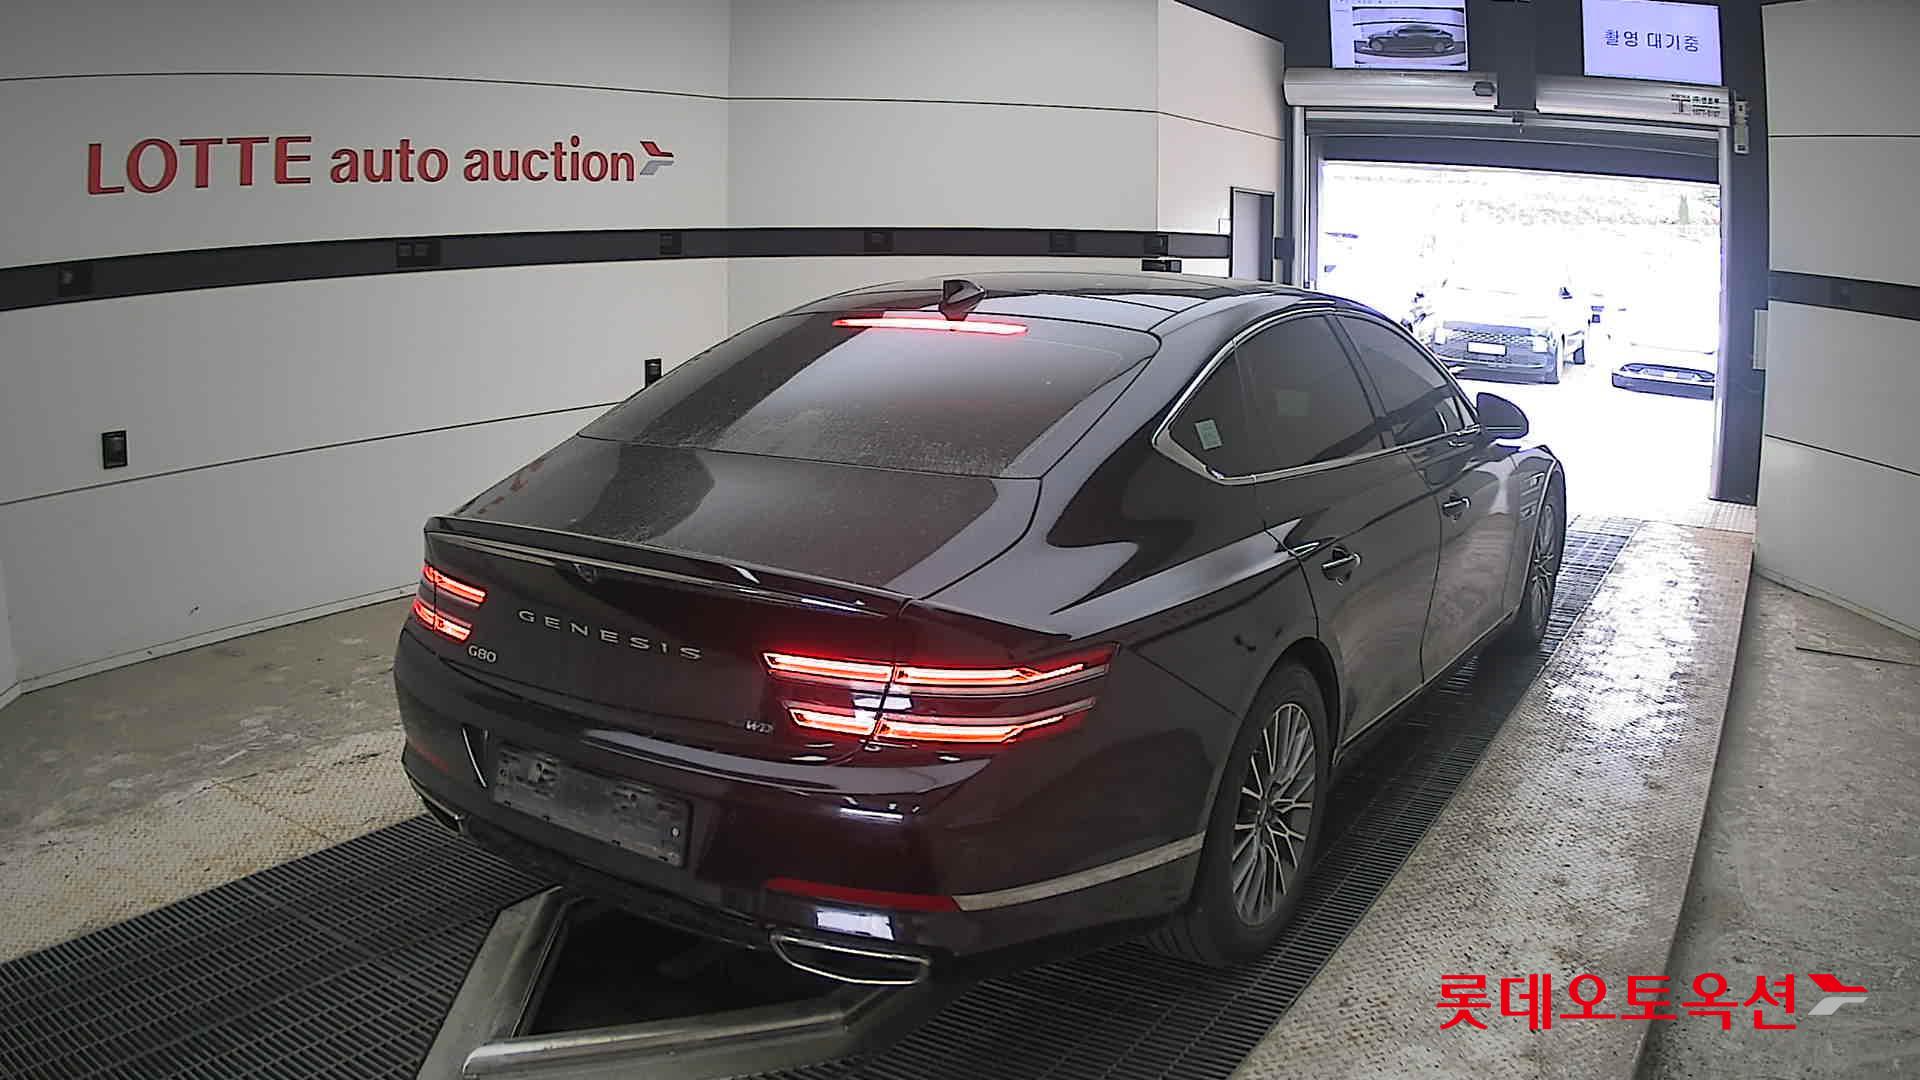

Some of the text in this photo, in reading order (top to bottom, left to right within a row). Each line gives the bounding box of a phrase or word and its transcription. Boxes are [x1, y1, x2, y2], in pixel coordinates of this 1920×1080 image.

[1647, 32, 1699, 53] 대기중
[87, 135, 636, 195] LOTTE auto auction
[517, 609, 702, 661] GENESIS
[468, 644, 497, 663] G80
